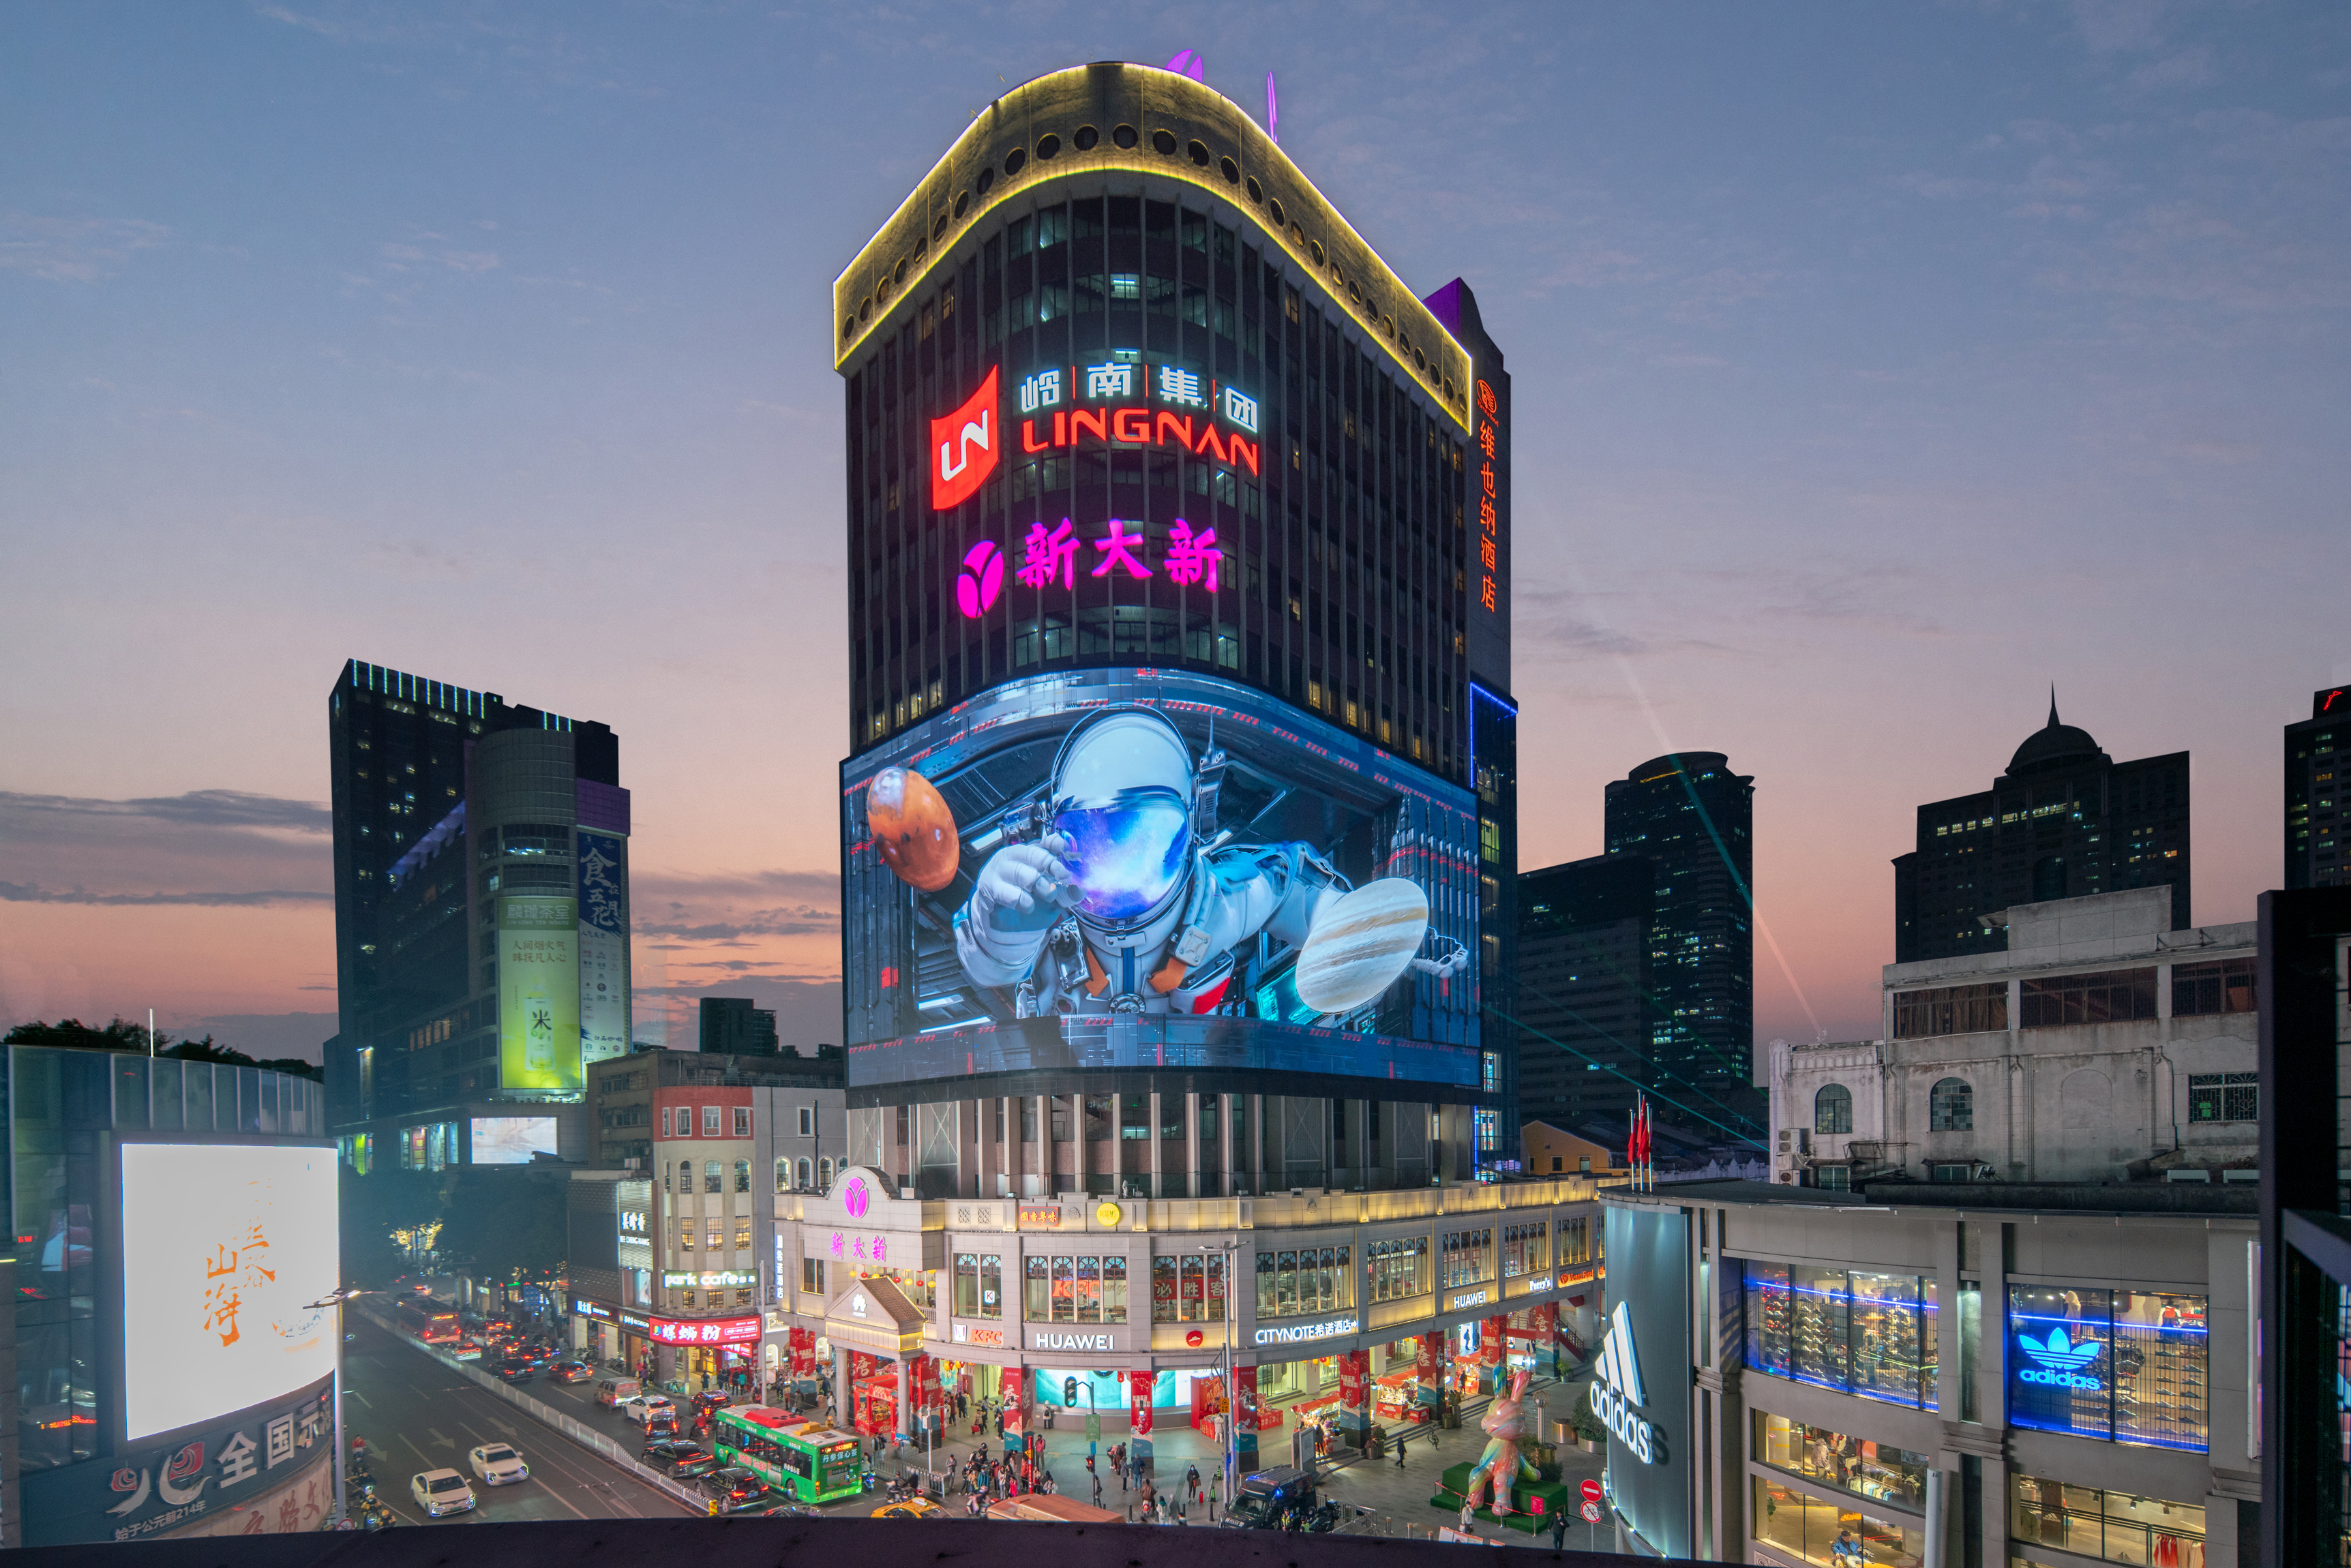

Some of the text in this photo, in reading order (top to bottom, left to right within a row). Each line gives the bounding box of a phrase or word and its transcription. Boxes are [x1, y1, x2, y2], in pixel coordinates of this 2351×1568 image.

[1020, 361, 1258, 434] 岭南集团
[1023, 408, 1258, 477] LINGNAN
[1479, 419, 1497, 613] 维也纳酒店
[1016, 516, 1225, 593] 新大新
[512, 940, 567, 951] 人间烟火气
[830, 1232, 886, 1262] 新大新
[664, 1272, 697, 1288] park
[700, 1271, 739, 1285] cafe
[1529, 1276, 1551, 1291] Perry's
[1051, 1280, 1100, 1298] KFC
[1156, 1281, 1225, 1298] 必胜客
[1453, 1291, 1486, 1309] HUAWEI
[662, 1324, 721, 1342] 螺蛳粉
[970, 1329, 1002, 1344] KFC
[1255, 1318, 1351, 1344] CITYNOTE 希诺酒店
[1036, 1333, 1115, 1350] HUAWEI
[2020, 1368, 2101, 1391] adidas
[1590, 1381, 1653, 1464] adidas
[822, 1448, 858, 1463] 丹参保心茶
[115, 1500, 207, 1543] 始于公元前214年
